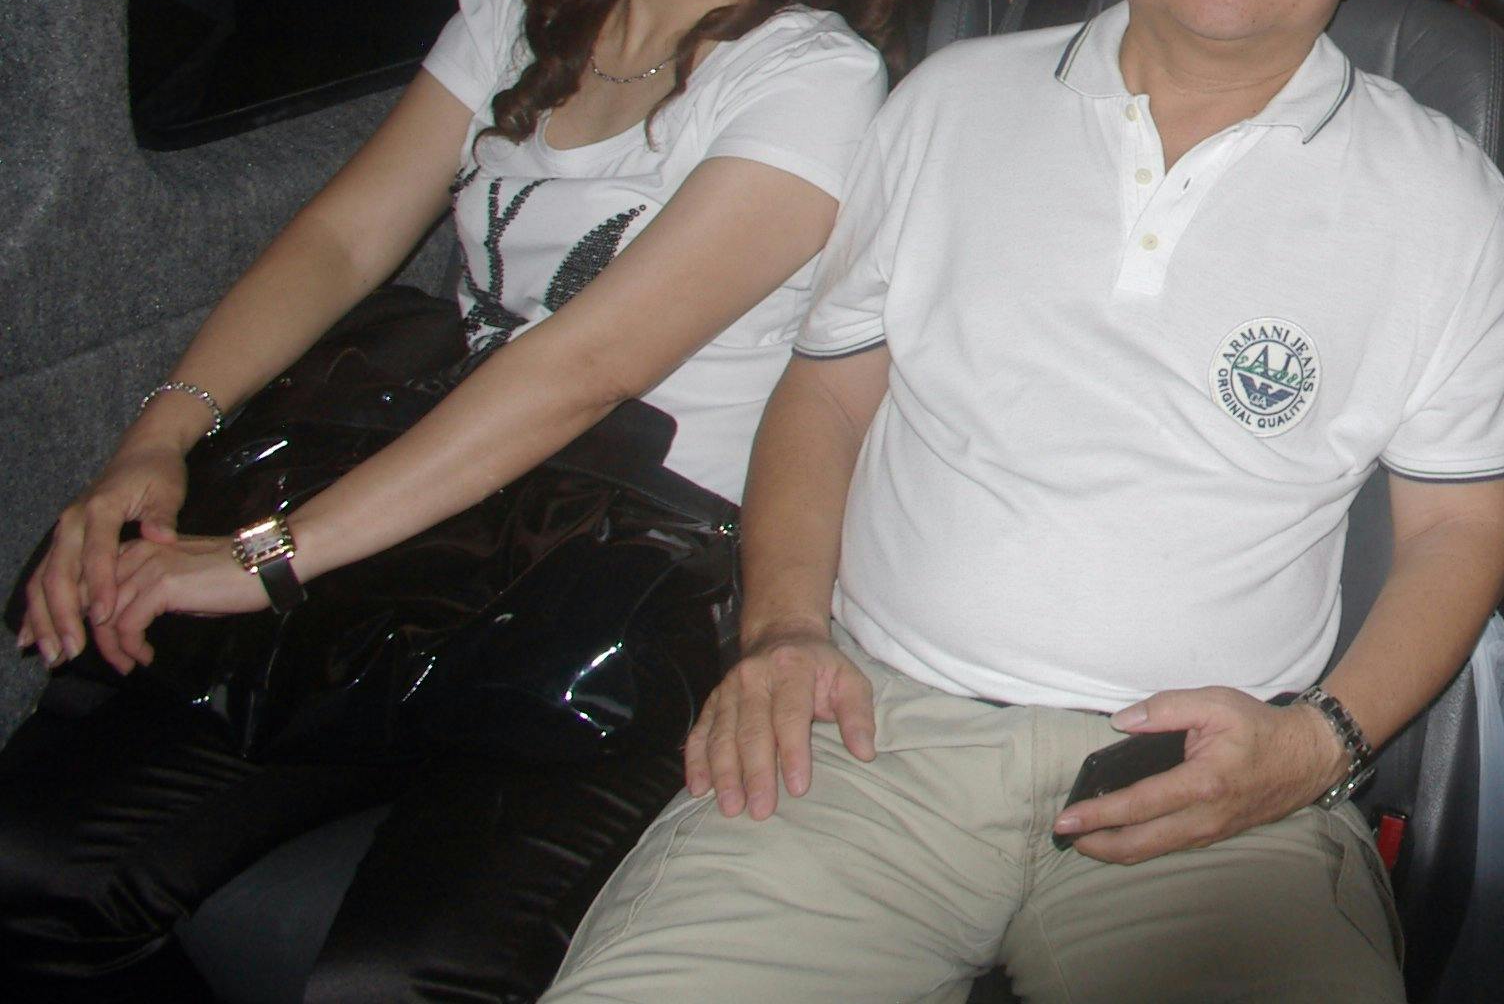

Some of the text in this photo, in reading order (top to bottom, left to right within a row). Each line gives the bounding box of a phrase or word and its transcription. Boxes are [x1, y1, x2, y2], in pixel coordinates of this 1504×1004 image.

[1222, 325, 1316, 392] ARMANI JEANS
[1218, 368, 1306, 428] ORIGINAL QUALITY
